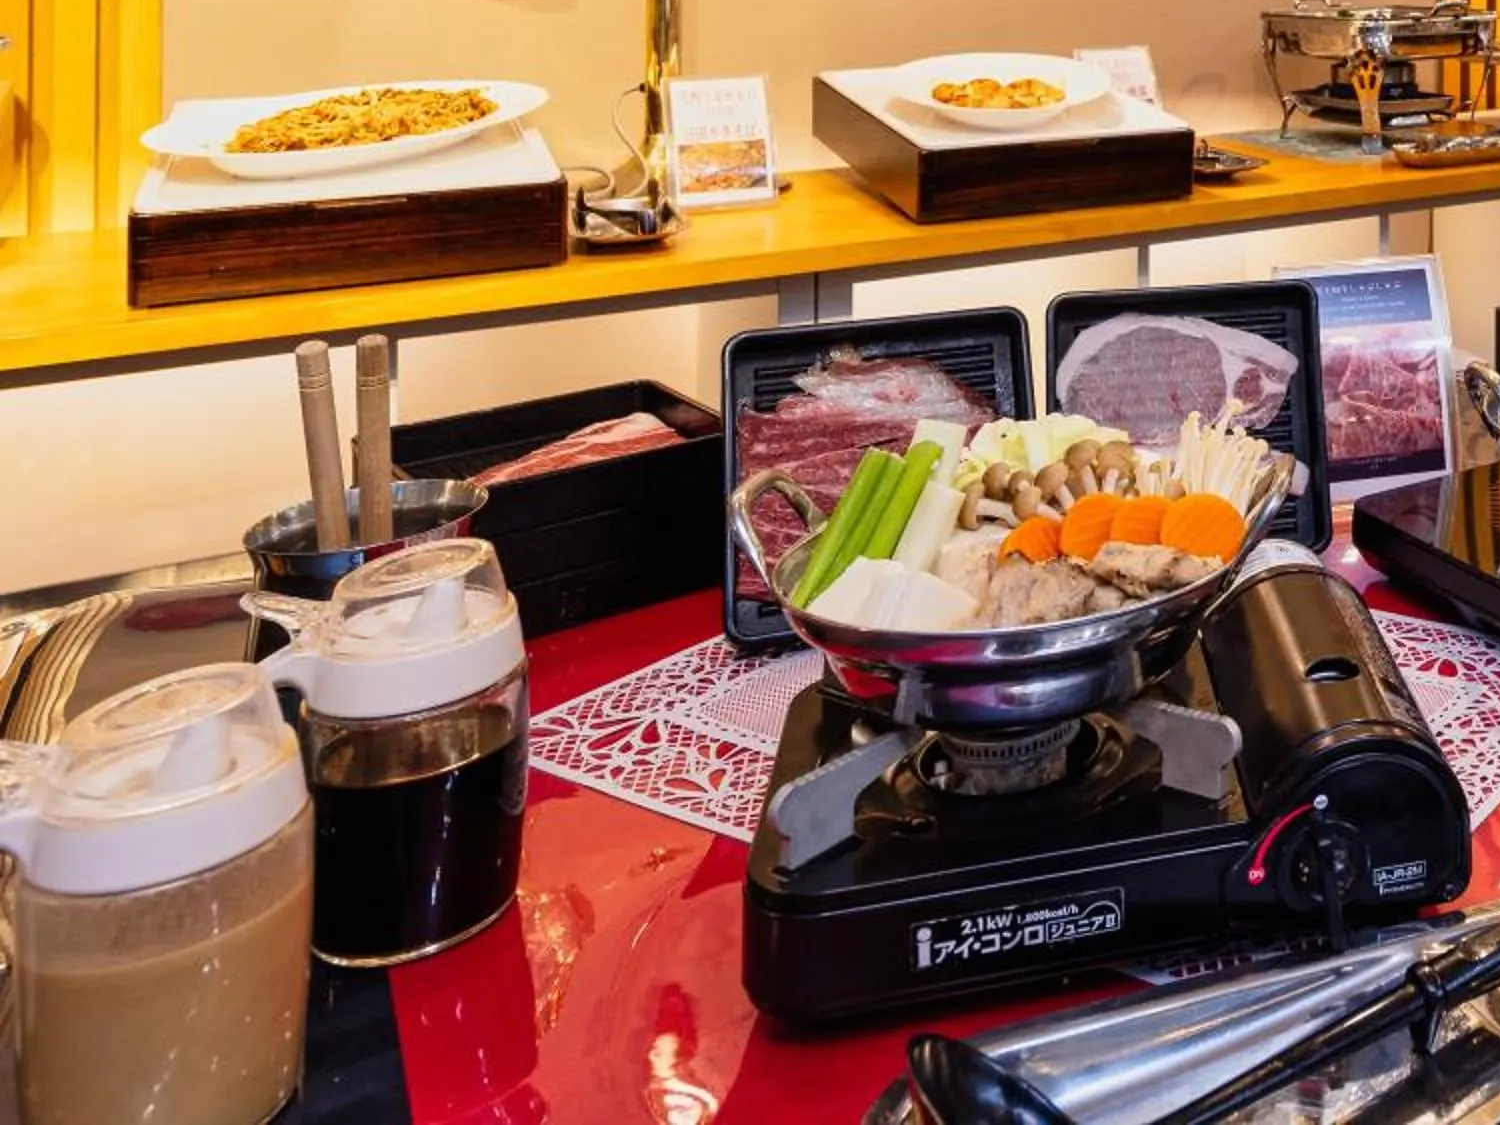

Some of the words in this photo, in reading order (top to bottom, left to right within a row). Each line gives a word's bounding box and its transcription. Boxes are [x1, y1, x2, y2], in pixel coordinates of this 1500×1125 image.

[961, 912, 1013, 935] 2.1kW
[933, 925, 1044, 963] アイ・コンロ
